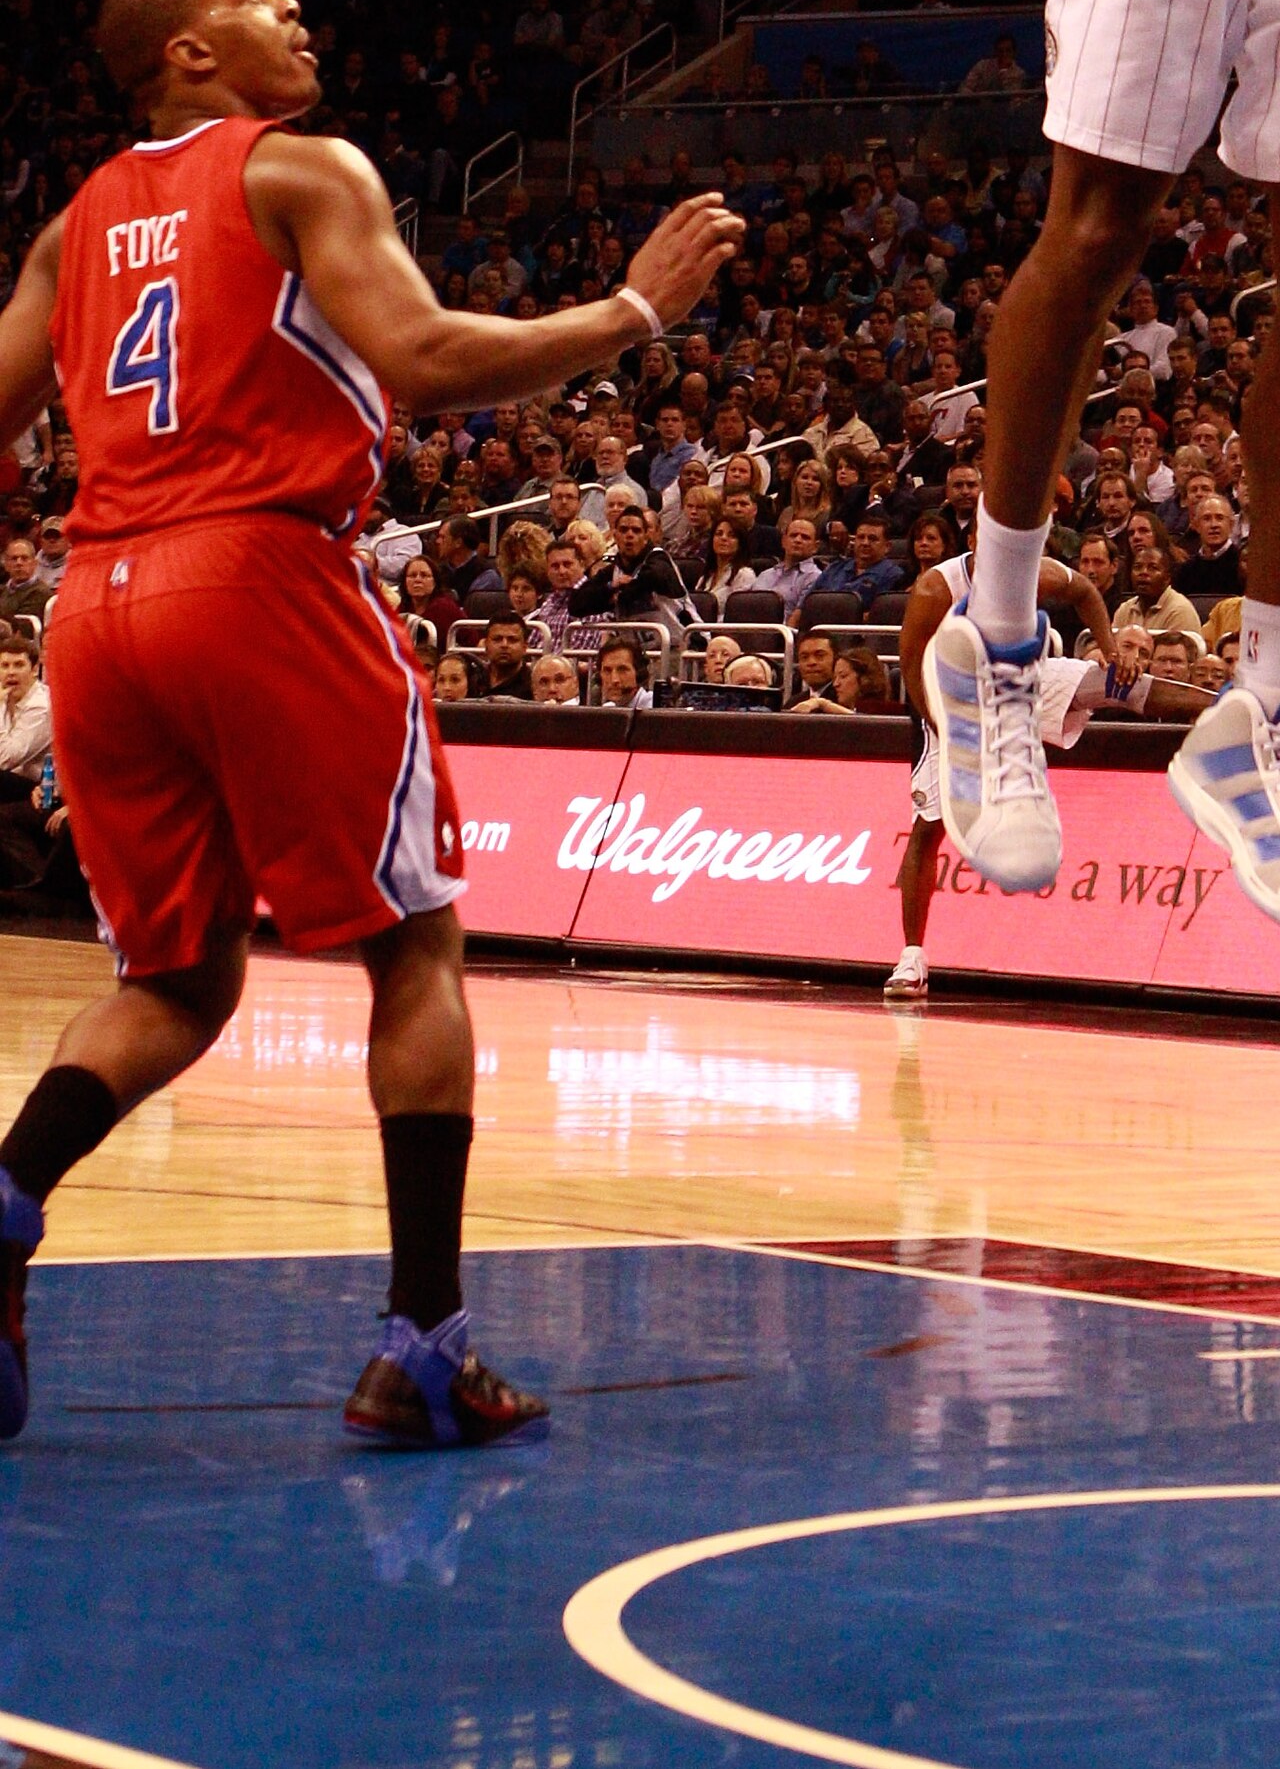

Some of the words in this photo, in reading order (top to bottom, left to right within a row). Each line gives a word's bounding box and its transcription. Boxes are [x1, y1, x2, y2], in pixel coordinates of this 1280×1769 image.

[106, 209, 188, 277] FOYE
[106, 276, 180, 436] 4
[557, 793, 871, 902] Walgreens
[1071, 860, 1100, 901] a
